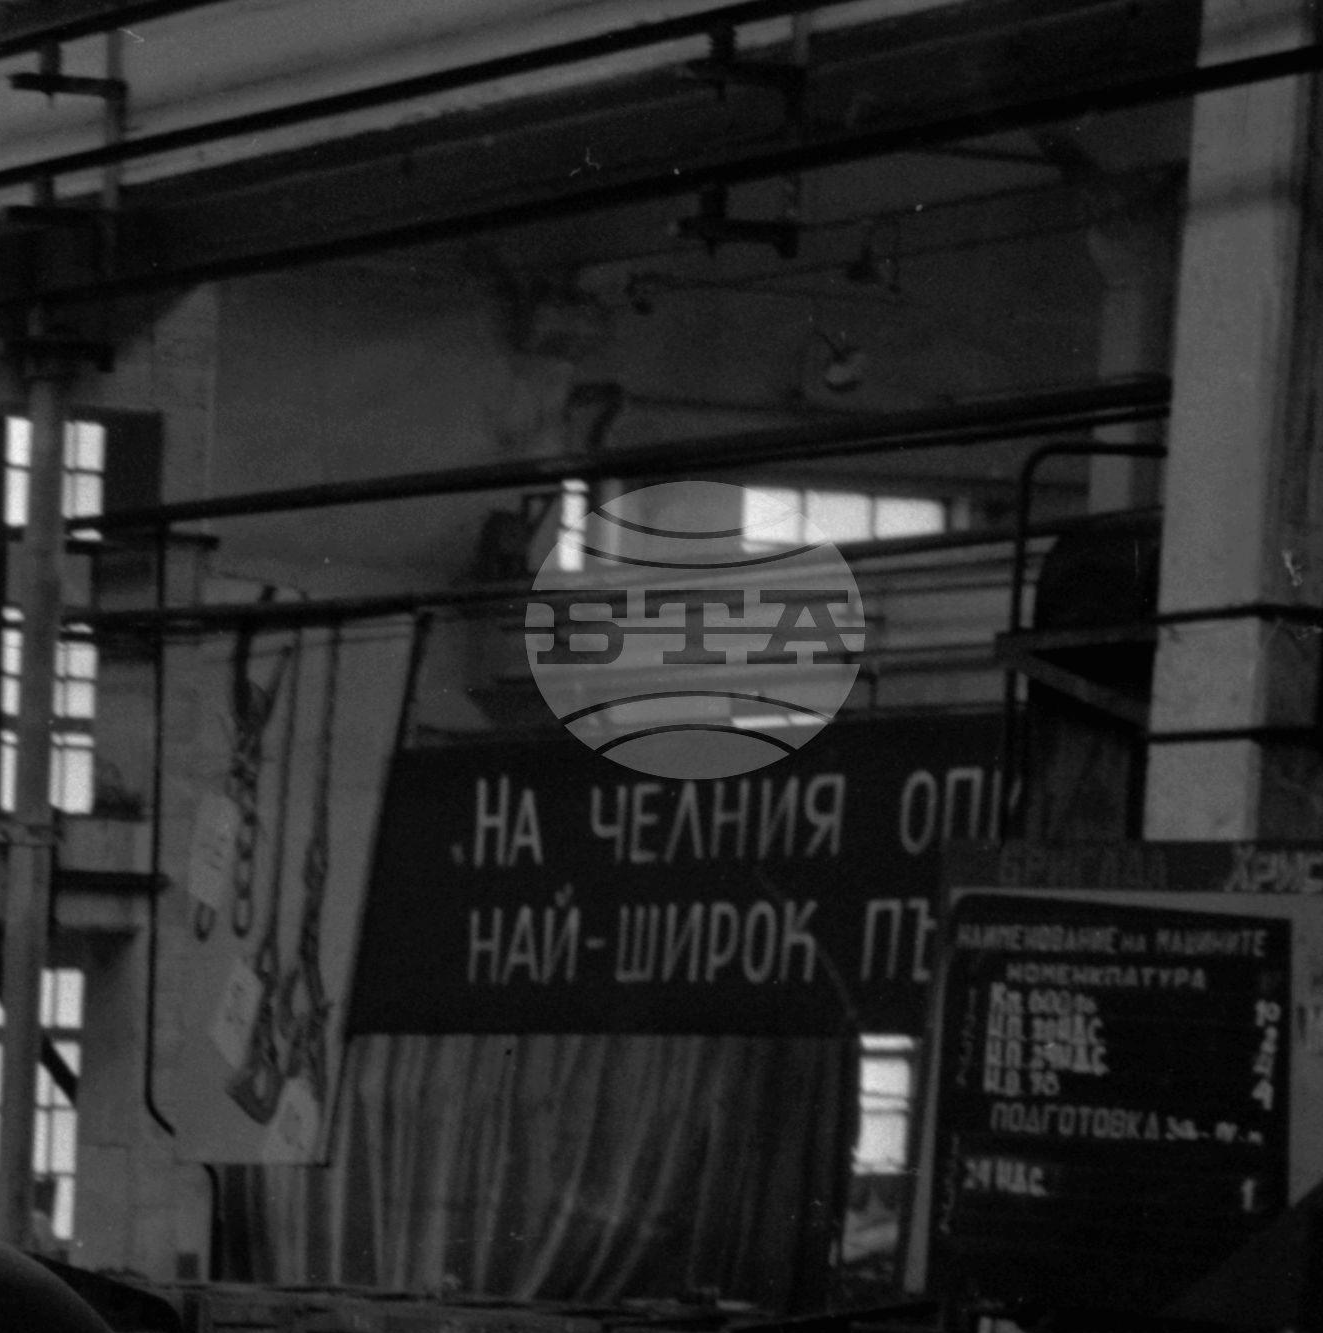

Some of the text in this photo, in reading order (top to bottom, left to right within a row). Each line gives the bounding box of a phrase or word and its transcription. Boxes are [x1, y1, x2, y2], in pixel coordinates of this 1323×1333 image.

[590, 773, 846, 864] ЧЕЛНИЯ
[468, 882, 818, 985] НАЙ-ШИРОК
[990, 1101, 1160, 1141] ПОДГОТОВКА
